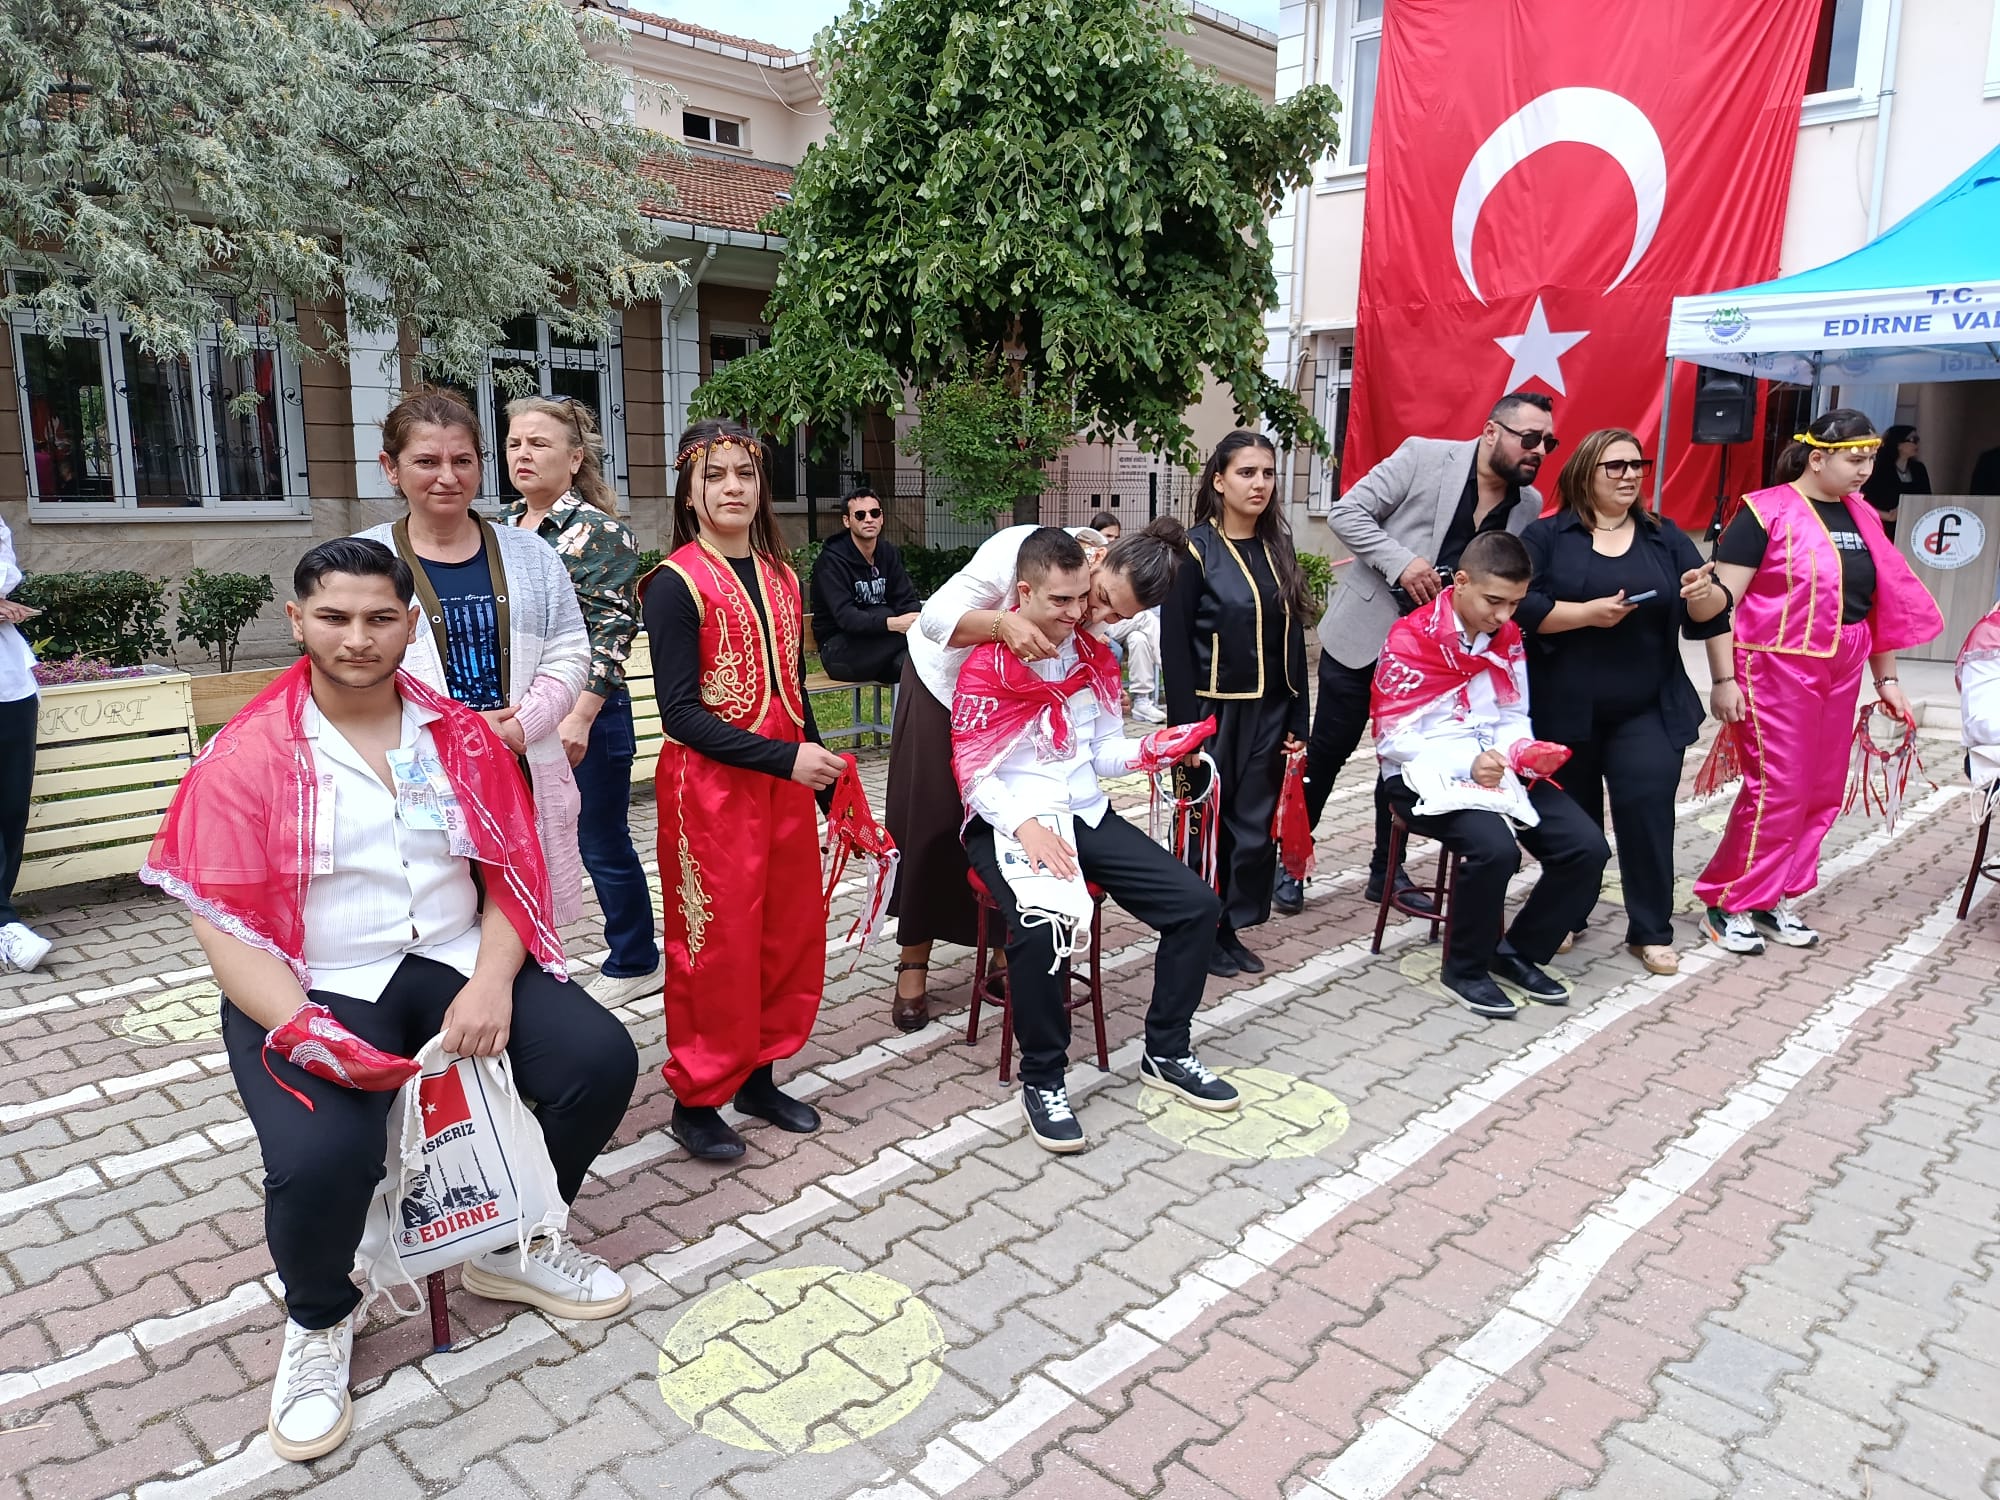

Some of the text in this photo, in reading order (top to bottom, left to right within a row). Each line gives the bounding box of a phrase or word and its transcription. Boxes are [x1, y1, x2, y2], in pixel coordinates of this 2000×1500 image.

[1926, 287, 1983, 306] T.C.
[1823, 313, 1932, 337] EDİRNE
[445, 808, 458, 831] 200
[418, 1200, 500, 1244] EDİRNE
